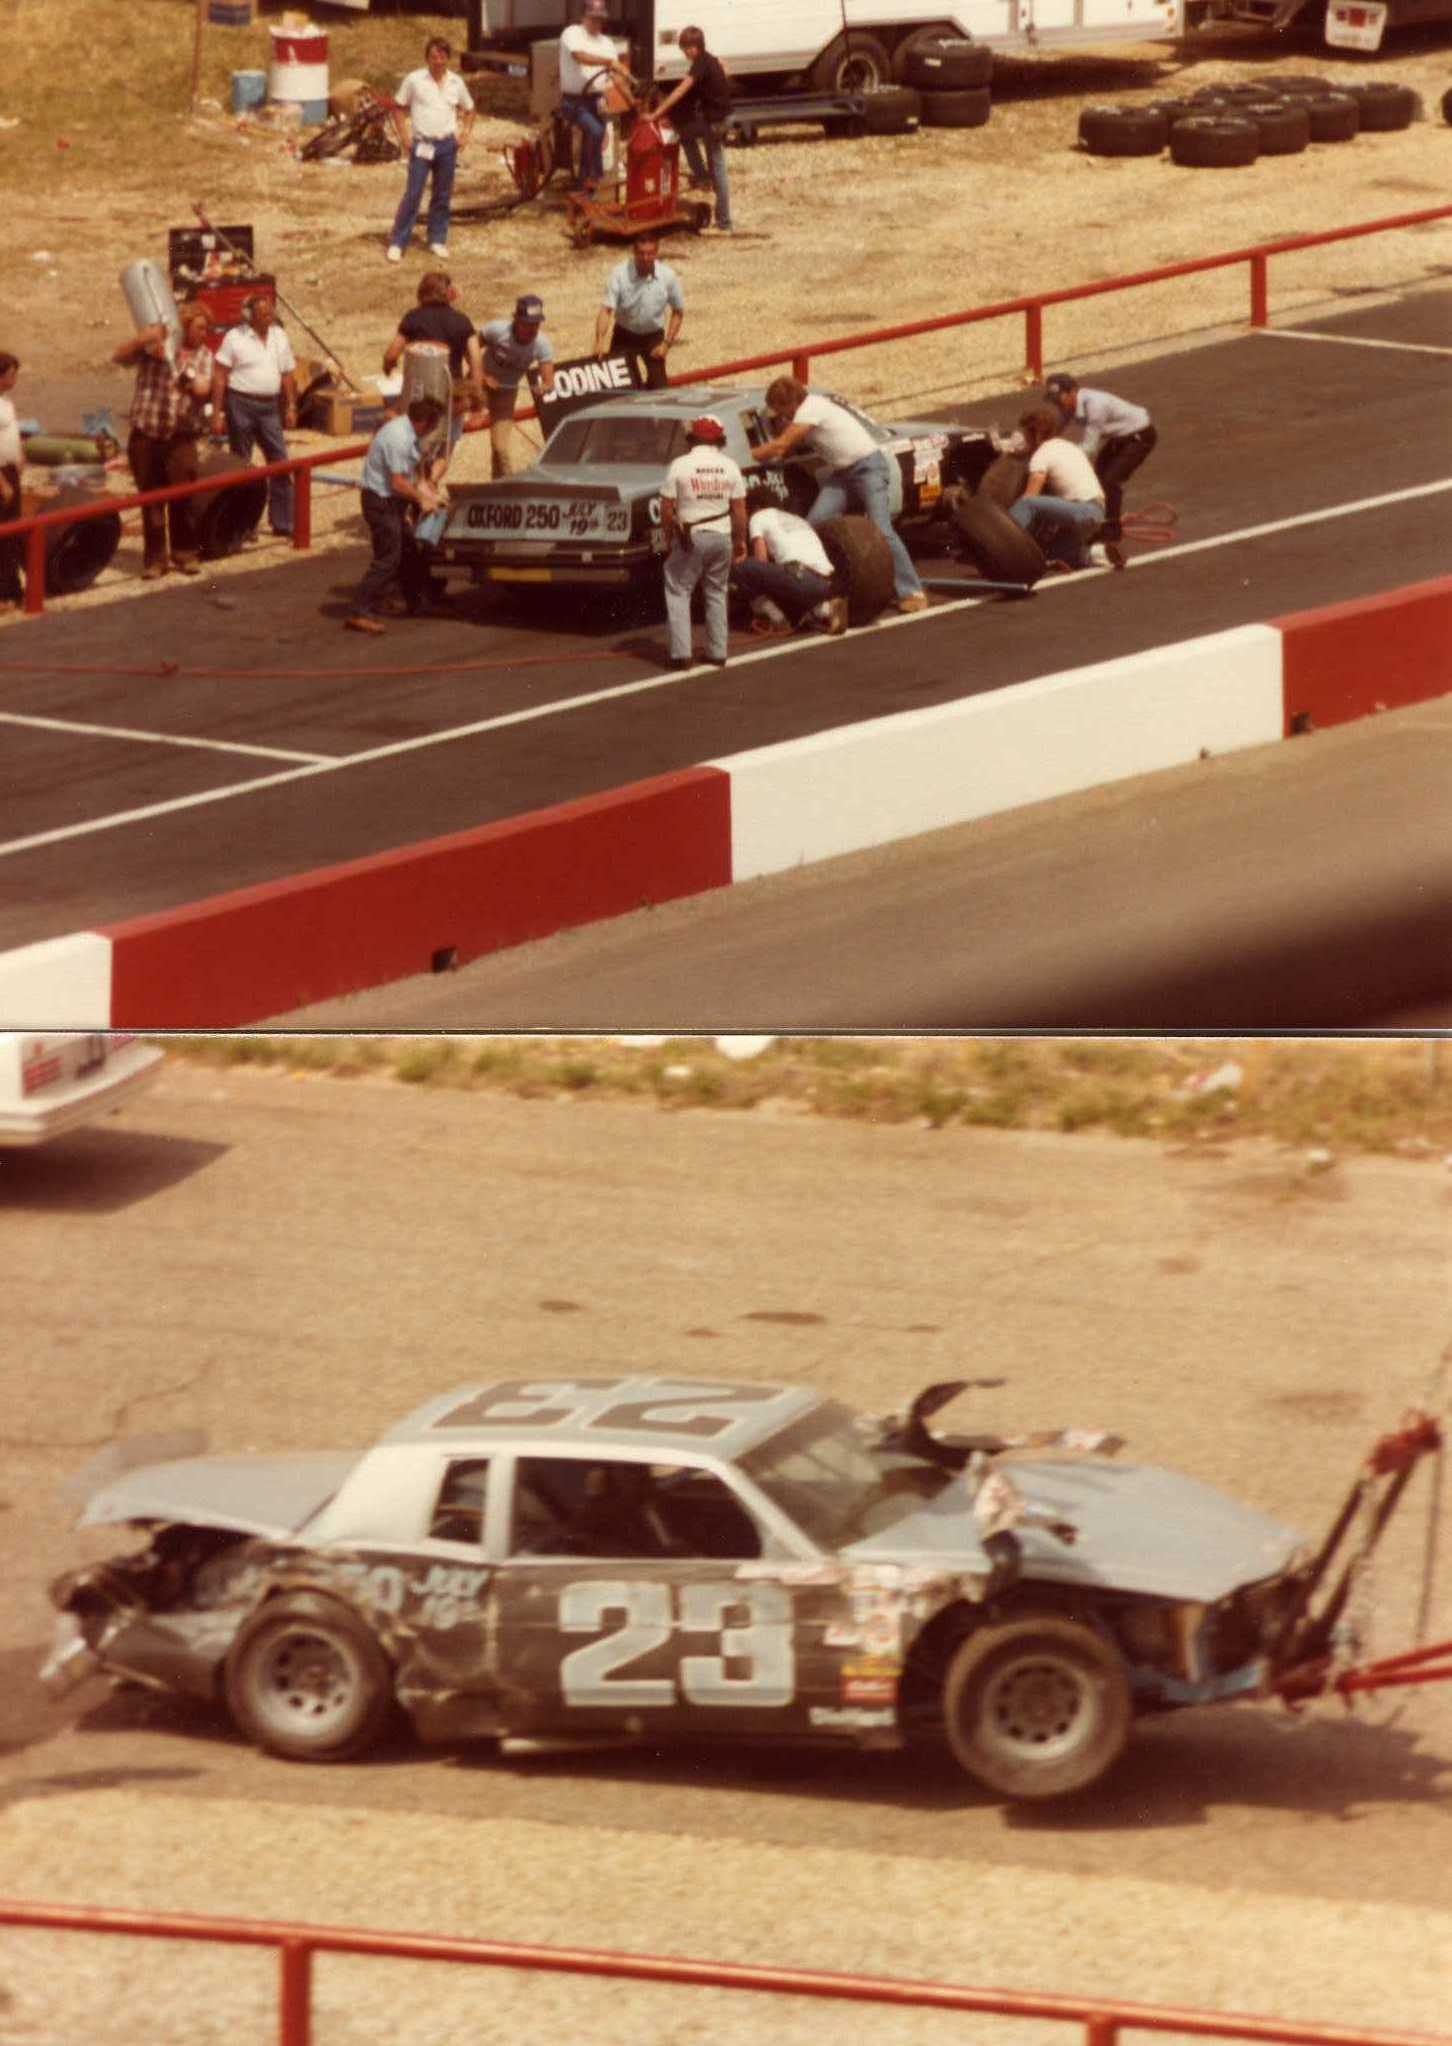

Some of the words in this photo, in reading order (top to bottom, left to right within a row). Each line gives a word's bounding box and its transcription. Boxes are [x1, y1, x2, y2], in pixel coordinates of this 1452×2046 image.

[467, 504, 522, 529] OXFORD
[526, 504, 560, 529] 250
[607, 512, 628, 532] 23
[559, 1580, 795, 1707] 23
